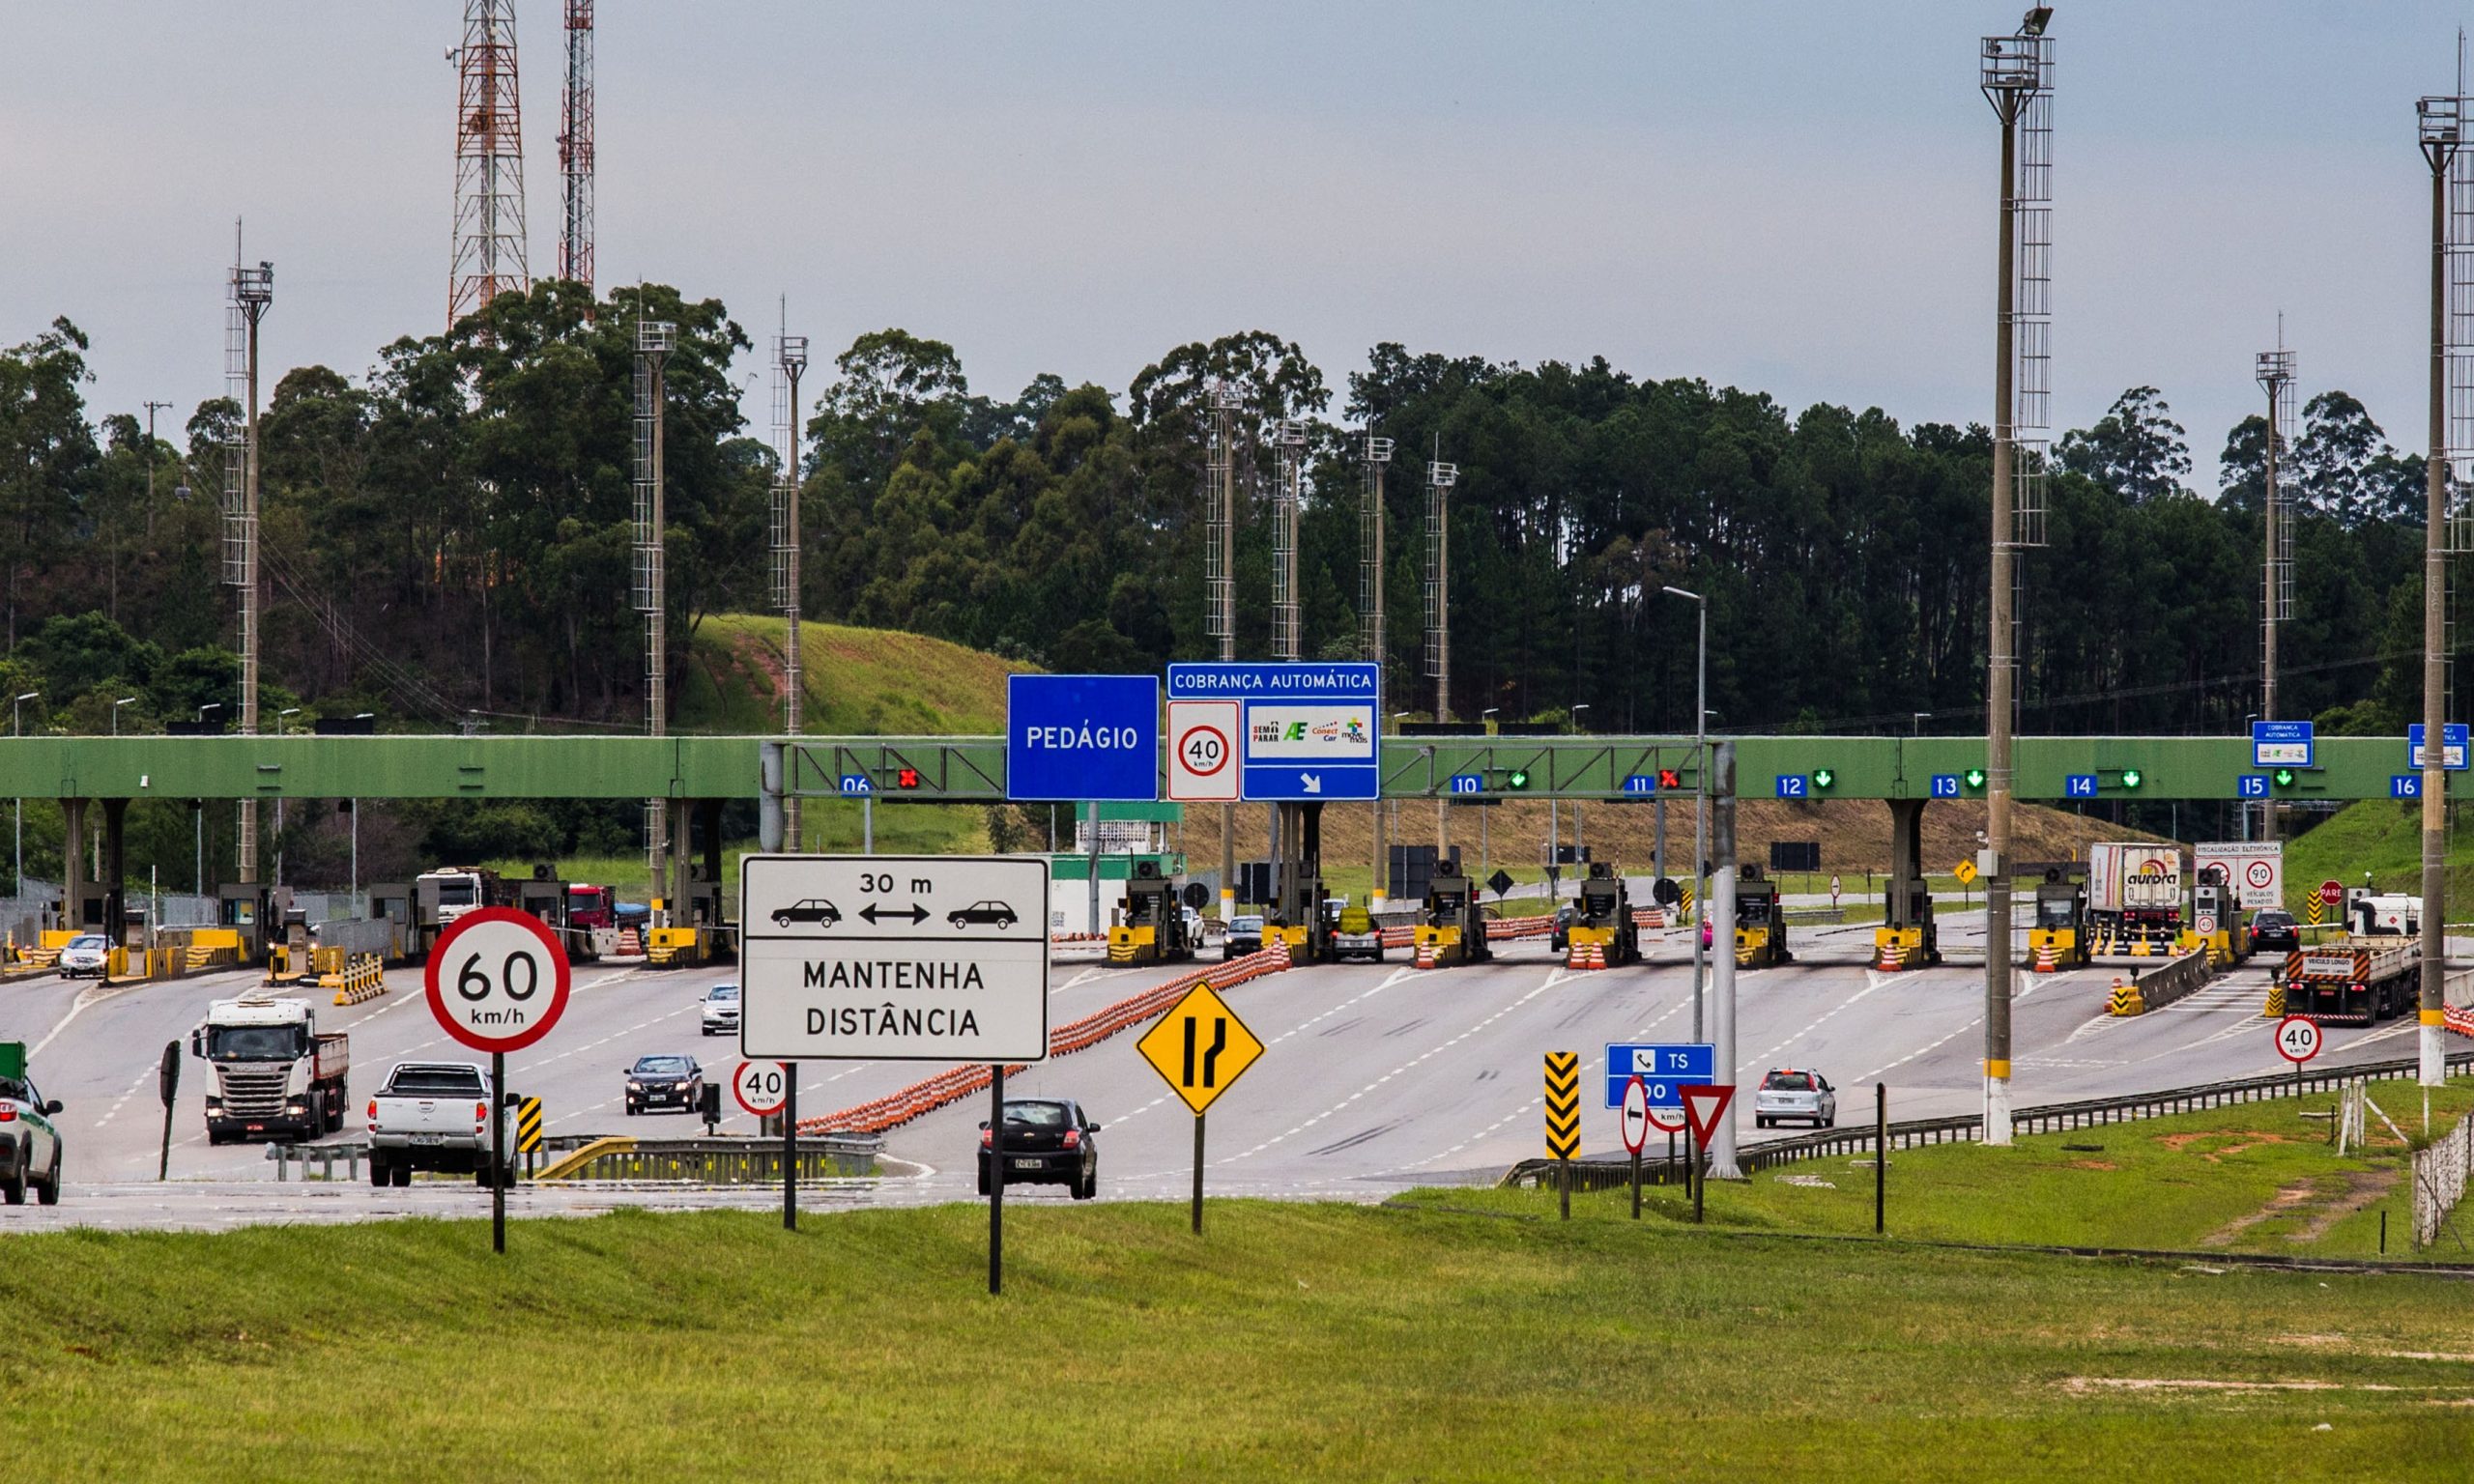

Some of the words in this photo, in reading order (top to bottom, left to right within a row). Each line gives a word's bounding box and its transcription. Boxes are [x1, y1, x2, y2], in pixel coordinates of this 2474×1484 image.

[1175, 673, 1263, 690] COBRANÇA
[1270, 669, 1372, 688] AUTOMÁTICA
[1027, 719, 1137, 749] PEDÁGIO
[1189, 740, 1219, 759] 40
[843, 777, 869, 791] 06
[1457, 777, 1477, 793] 10
[1633, 777, 1646, 791] 11
[1782, 778, 1801, 794] 12
[1937, 778, 1957, 794] 13
[2072, 778, 2091, 794] 14
[2244, 778, 2263, 794] 15
[2397, 778, 2415, 795] 16
[2128, 873, 2177, 885] aurora
[2253, 869, 2268, 879] 90
[859, 873, 894, 894] 30
[911, 877, 932, 894] m
[2320, 888, 2342, 898] PARE
[457, 950, 538, 1002] 60
[804, 961, 984, 990] MANTENHA
[472, 1008, 525, 1024] km/h
[807, 1002, 980, 1037] DISTÂNCIA
[2286, 1029, 2313, 1045] 40
[1668, 1053, 1688, 1070] TS
[746, 1071, 782, 1095] 40
